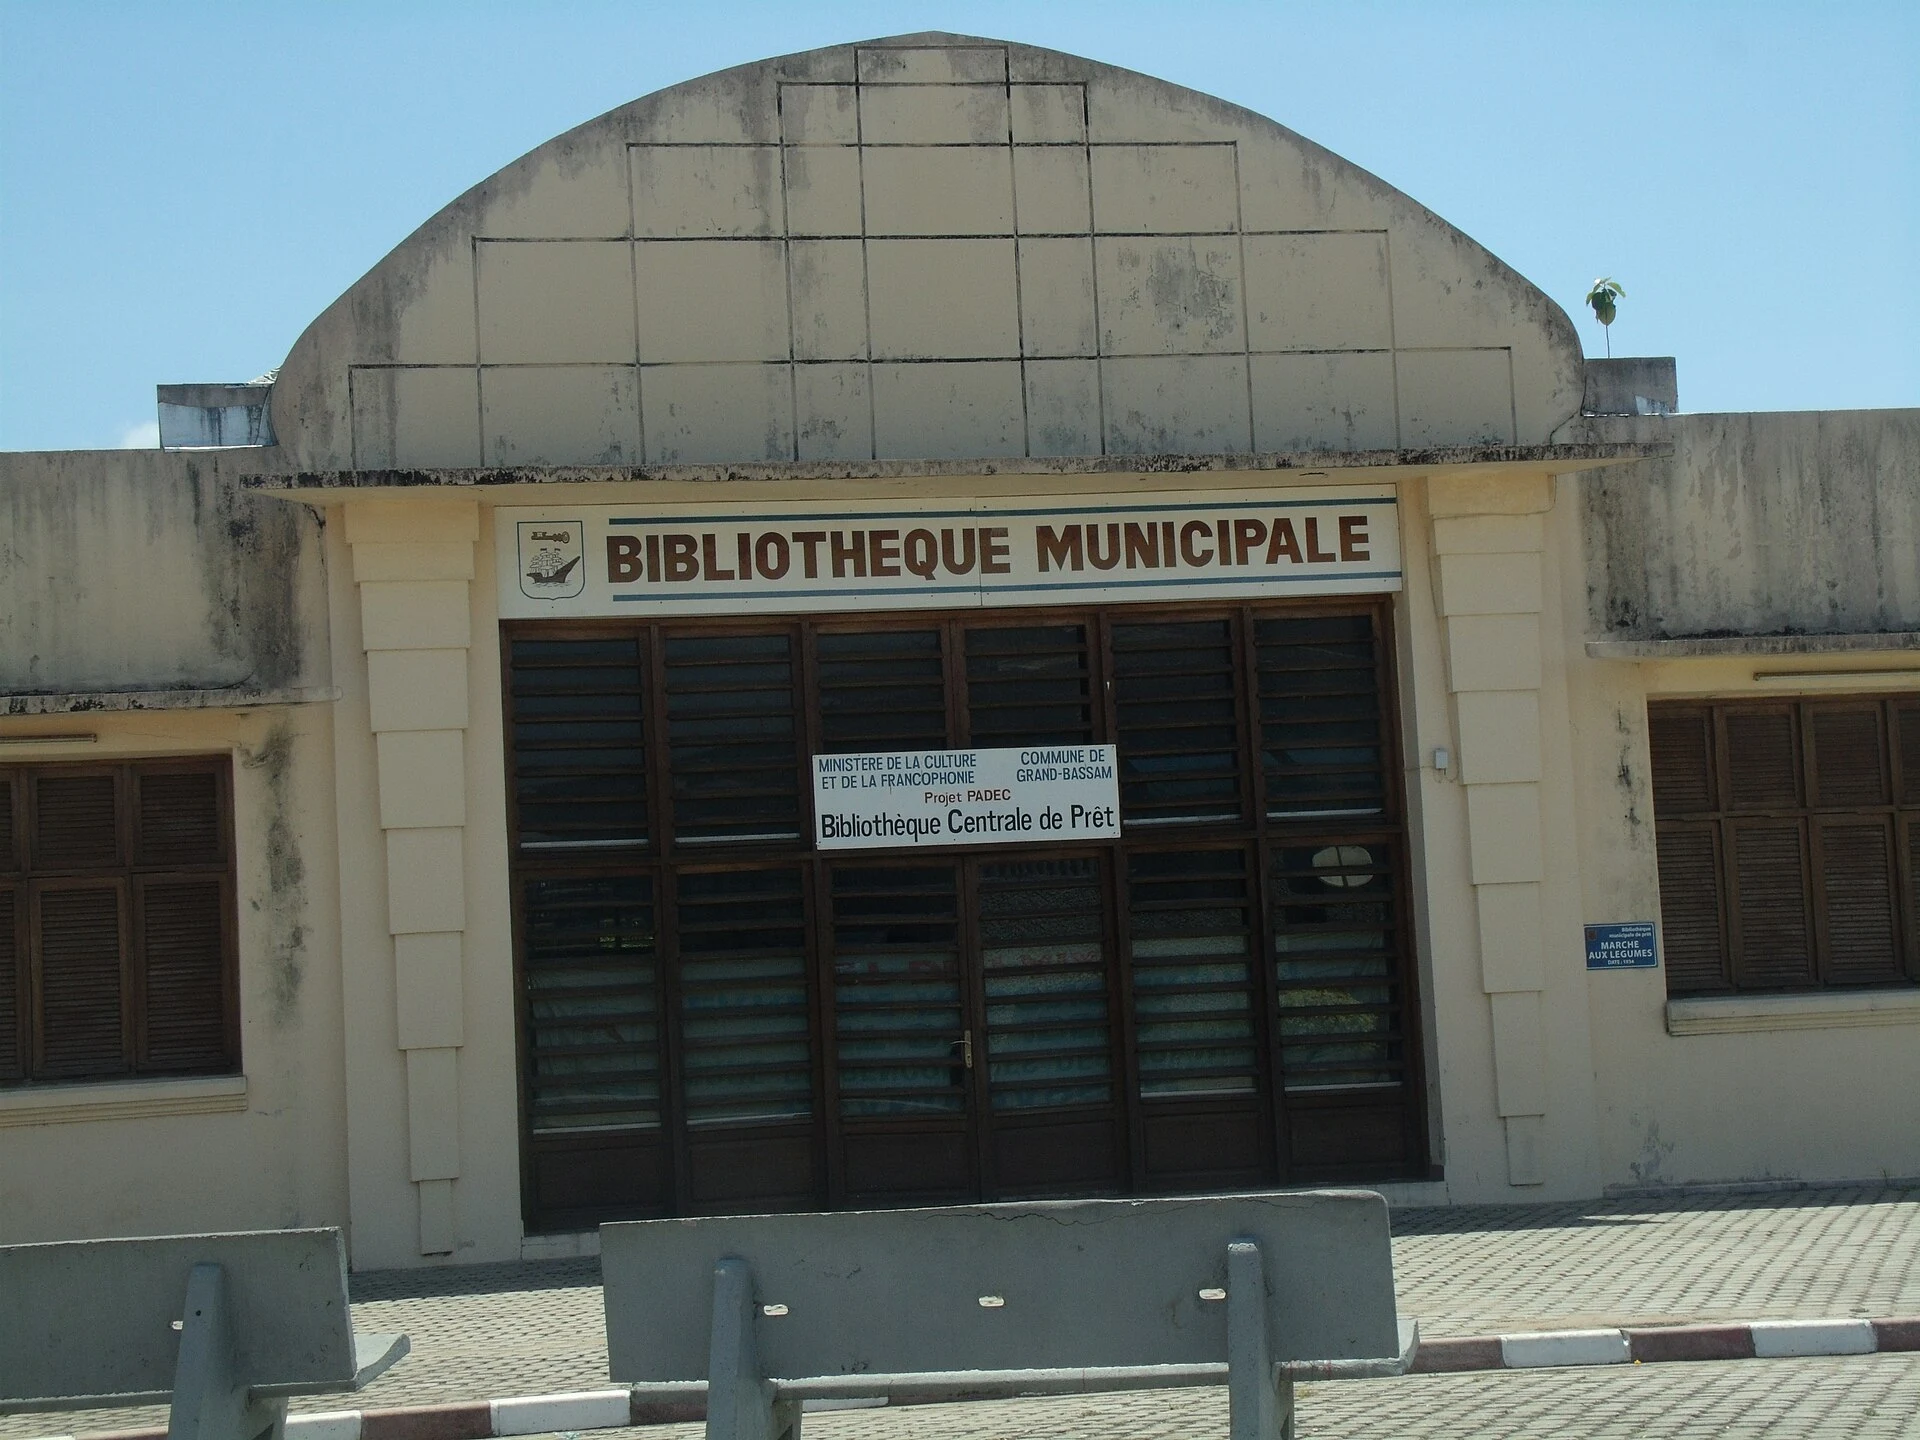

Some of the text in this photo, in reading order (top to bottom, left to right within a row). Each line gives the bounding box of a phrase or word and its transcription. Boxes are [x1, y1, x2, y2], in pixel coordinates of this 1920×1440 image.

[606, 515, 1371, 583] BIBLIOTHEQUE MUNICIPALE
[818, 753, 977, 773] MINISTERE DE LA CULTURE
[1020, 748, 1105, 765] COMMUNE DE
[821, 771, 975, 790] ET DE LA FRANCOPHONIE
[1016, 766, 1112, 783] GRAND-BASSAM
[924, 788, 1011, 807] Projet PADEC
[821, 804, 1115, 842] Bibliothèque Centrale de Prêt
[1588, 949, 1653, 960] AUX LEGUMES
[1600, 940, 1640, 950] MARCHE
